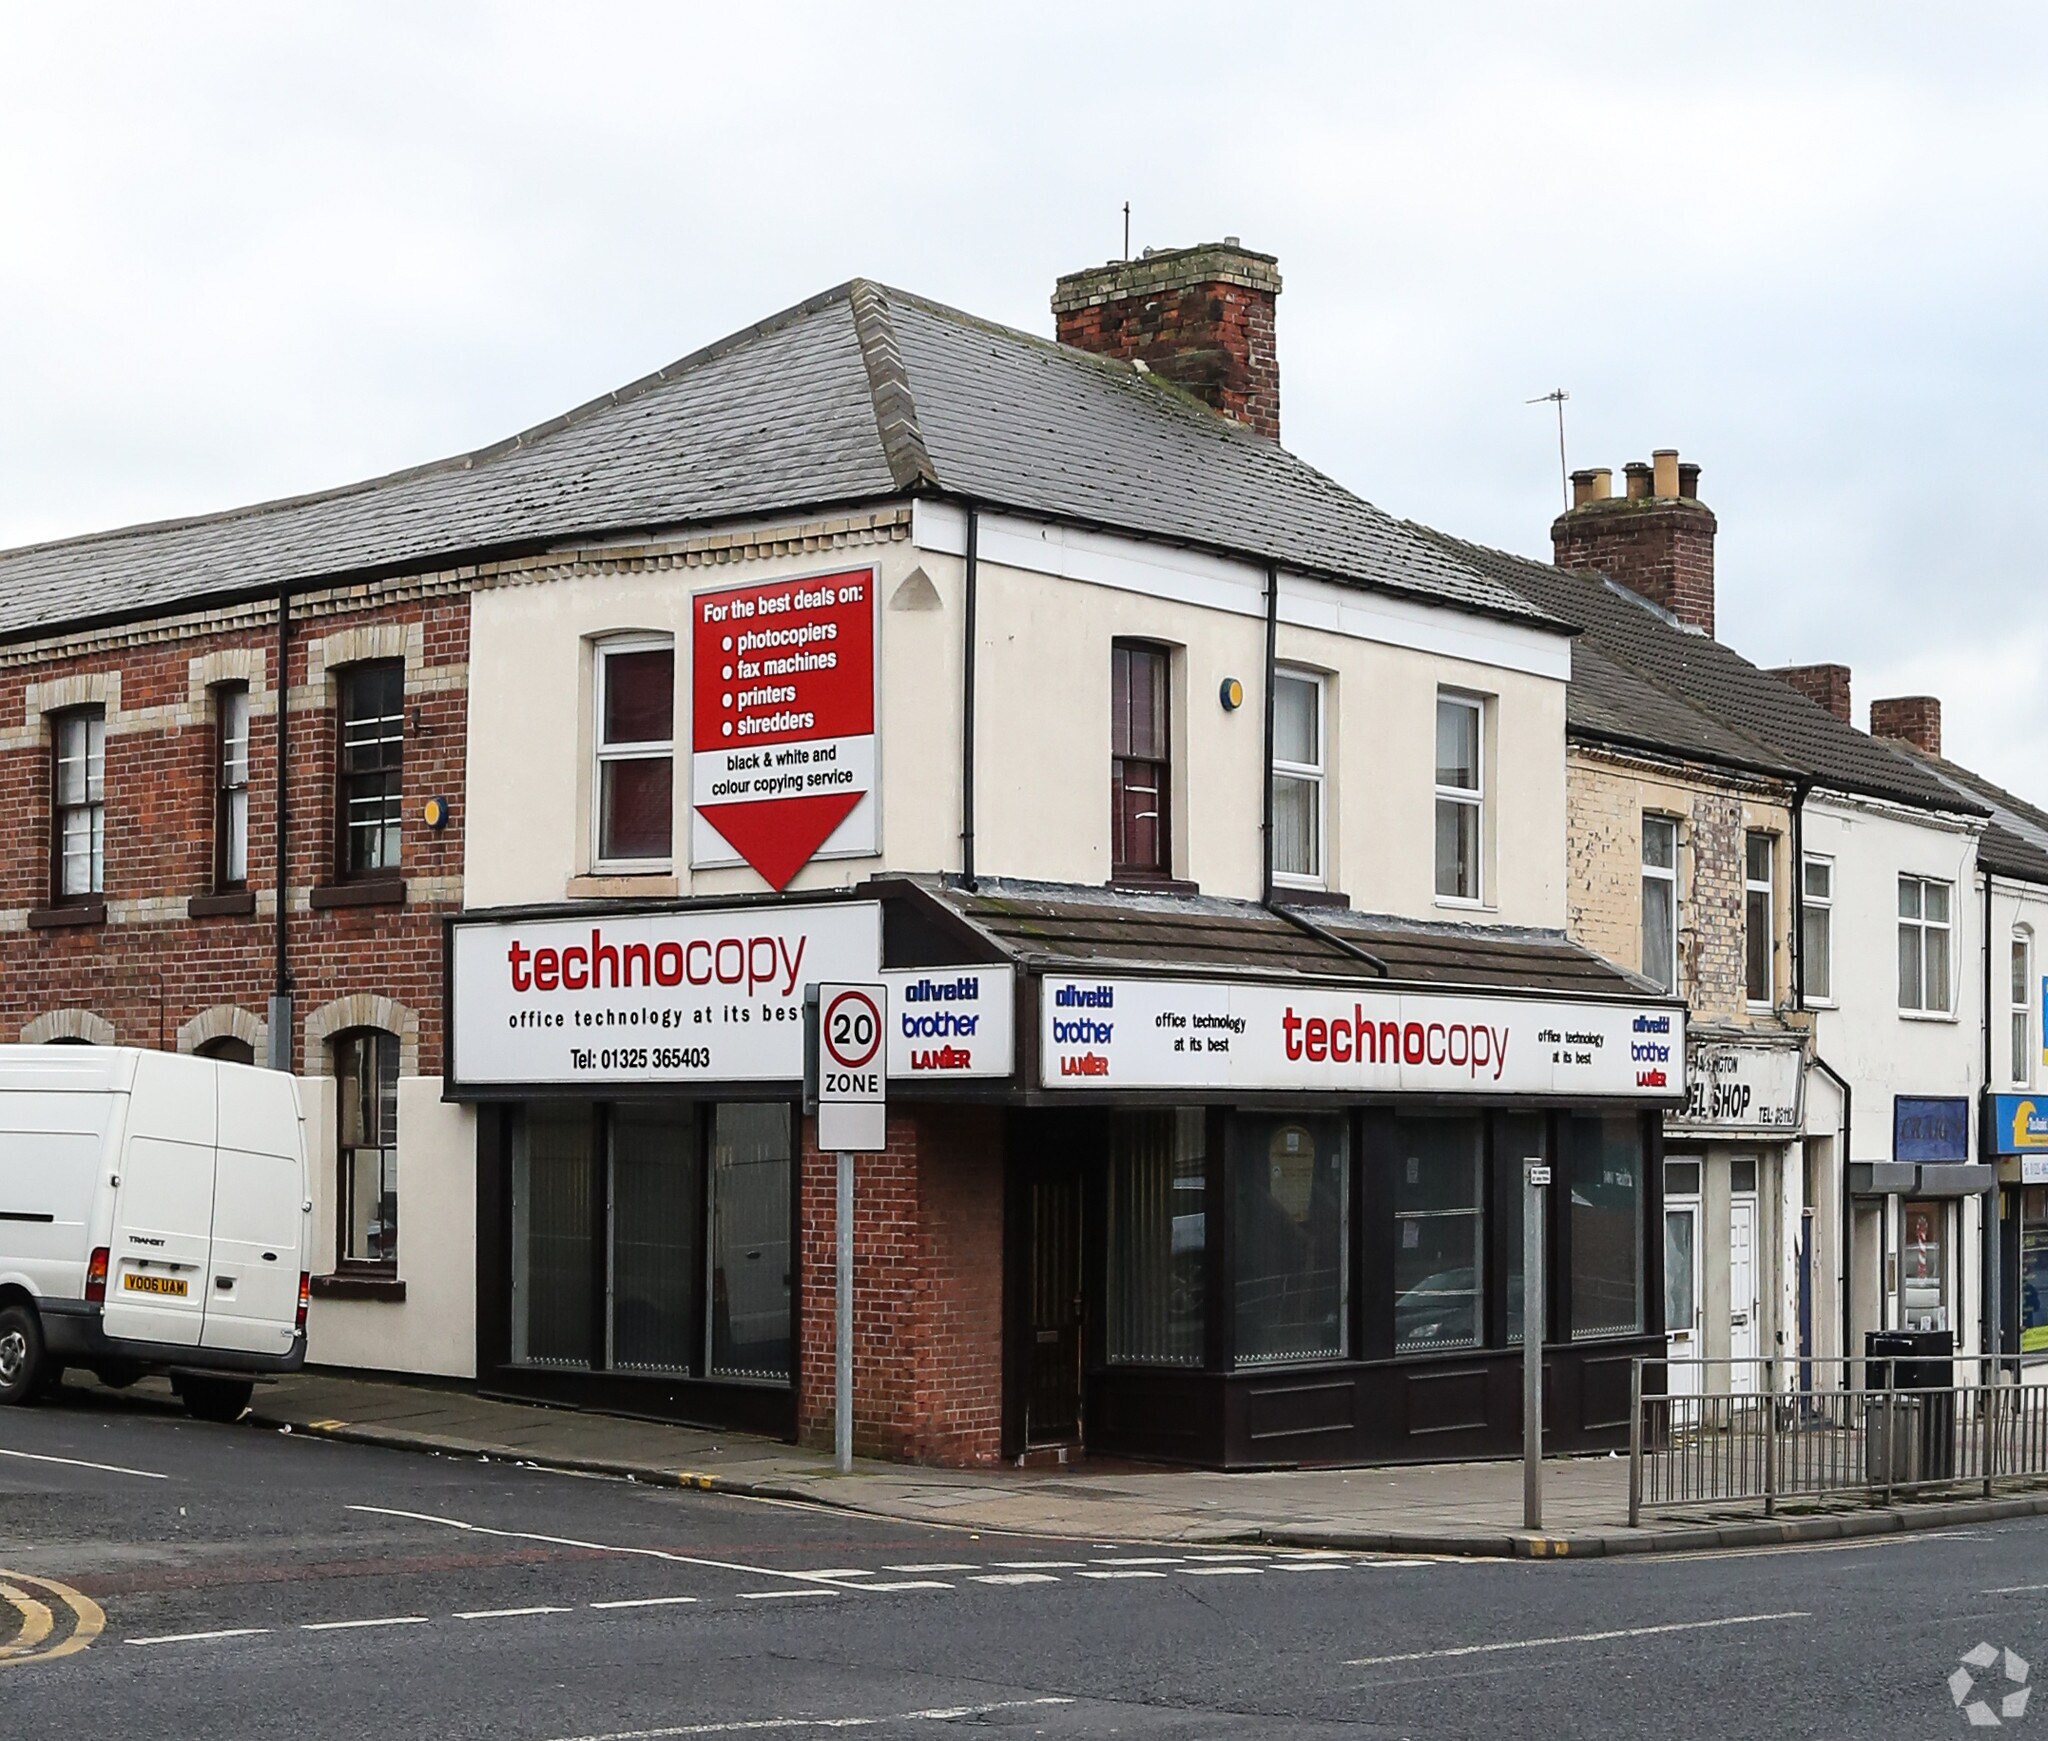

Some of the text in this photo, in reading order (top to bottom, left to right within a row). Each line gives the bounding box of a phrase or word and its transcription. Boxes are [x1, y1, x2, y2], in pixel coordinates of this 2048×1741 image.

[704, 587, 862, 622] For the best deals on:
[738, 622, 837, 655] photocopiers
[738, 652, 836, 678] fax machines
[738, 685, 796, 712] printers
[738, 711, 813, 735] shredders
[728, 745, 836, 770] black & white and
[712, 769, 852, 795] colour copying service
[508, 929, 807, 996] technocopy
[906, 978, 978, 1002] olivetti
[1056, 985, 1113, 1008] olivetti
[510, 1011, 563, 1028] office
[575, 1008, 681, 1028] technology
[694, 1007, 711, 1023] at
[725, 1006, 749, 1022] its
[902, 1012, 979, 1038] brother
[1156, 1013, 1245, 1033] office technology
[834, 1014, 873, 1045] 20
[1054, 1017, 1113, 1043] brother
[1538, 1030, 1603, 1047] office technology
[1175, 1037, 1229, 1051] at its best
[1283, 1004, 1509, 1080] technocopy
[1632, 1042, 1669, 1062] brother
[571, 1048, 709, 1069] Tel: 01325 365403
[1576, 1052, 1591, 1064] best
[826, 1074, 878, 1092] ZONE
[1712, 1083, 1751, 1118] SHOP
[129, 1235, 165, 1246] TRANSIT
[162, 1279, 185, 1295] UAM
